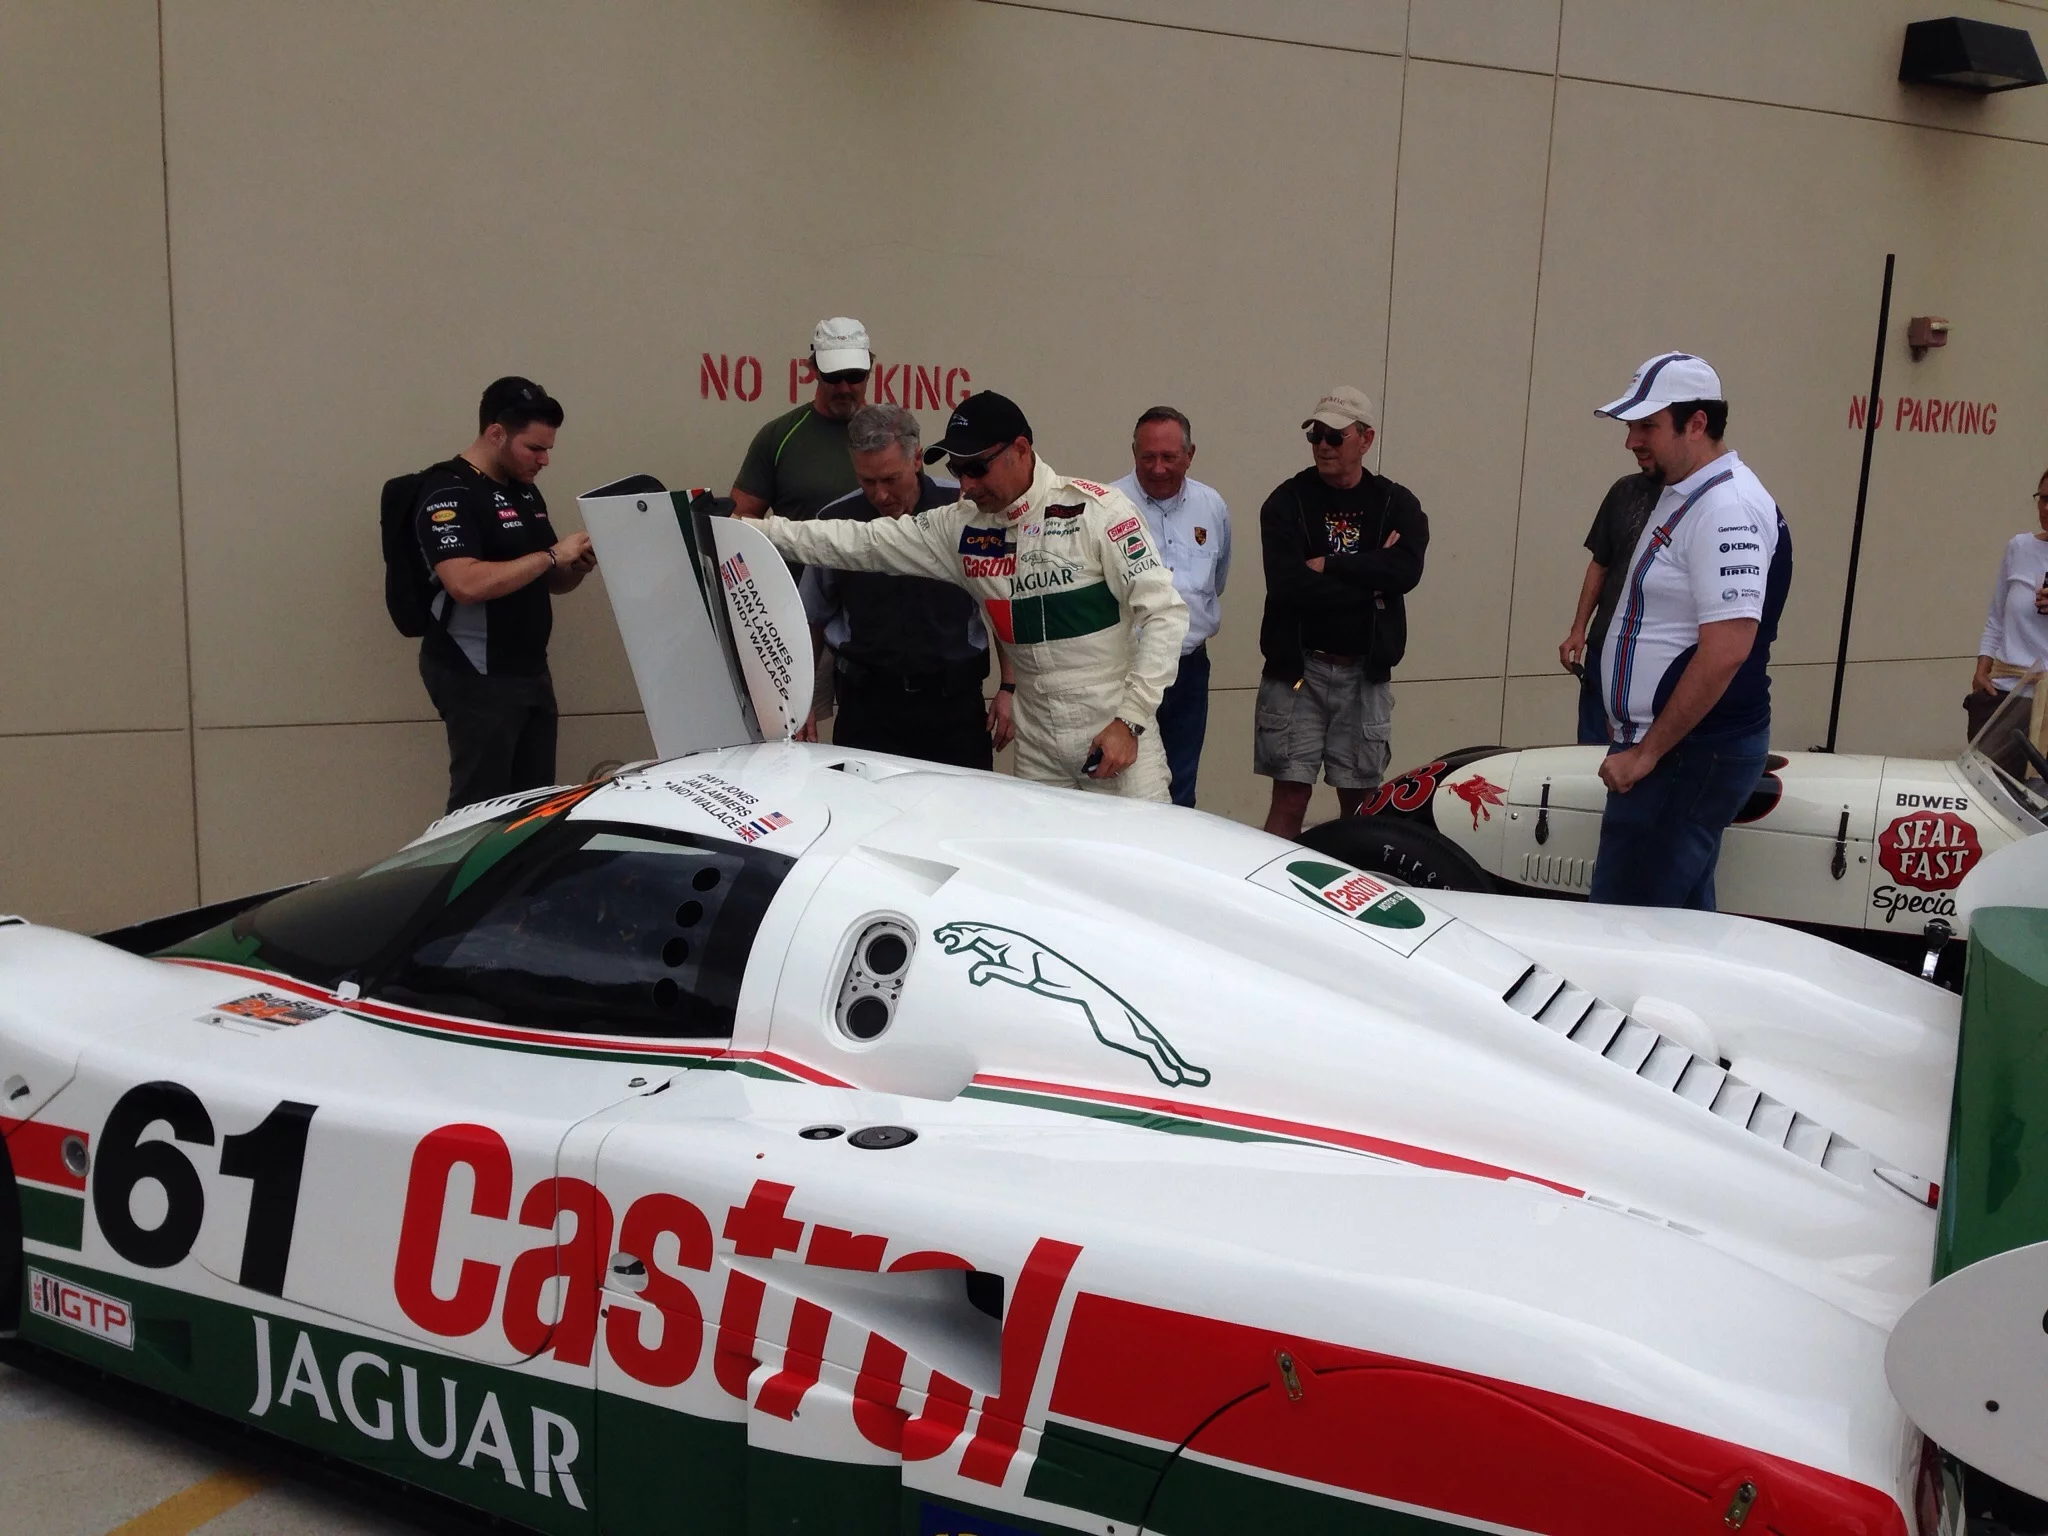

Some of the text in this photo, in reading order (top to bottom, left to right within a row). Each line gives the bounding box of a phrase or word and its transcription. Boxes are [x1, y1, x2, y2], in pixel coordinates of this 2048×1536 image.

[700, 353, 971, 411] NO PKING
[1896, 397, 1997, 435] PARKING
[426, 501, 458, 512] RENAULT
[1007, 501, 1030, 521] Castrol
[1110, 519, 1137, 538] SIMPSON
[1718, 525, 1750, 533] Genworth
[1731, 543, 1760, 552] KEMPPI
[962, 553, 1017, 578] Castrol
[1009, 568, 1075, 597] JAGUAR
[1720, 564, 1760, 577] PIRELLI
[738, 587, 792, 685] JAN LAMMERS
[745, 579, 793, 666] DAVY JONES
[730, 592, 788, 697] ANDY WALLACE
[667, 784, 742, 829] ANDY WALLACE
[682, 779, 752, 818] JAN LAMMERS
[697, 773, 760, 805] DAVY JONES
[1896, 792, 1969, 811] BOWES
[1893, 818, 1967, 850] SEAL
[1899, 850, 1970, 881] FAST
[1323, 873, 1388, 912] Castrol
[93, 1080, 319, 1298] 61
[60, 1288, 127, 1332] GTP
[394, 1123, 1084, 1488] Castrol
[248, 1315, 588, 1511] JAGUAR
